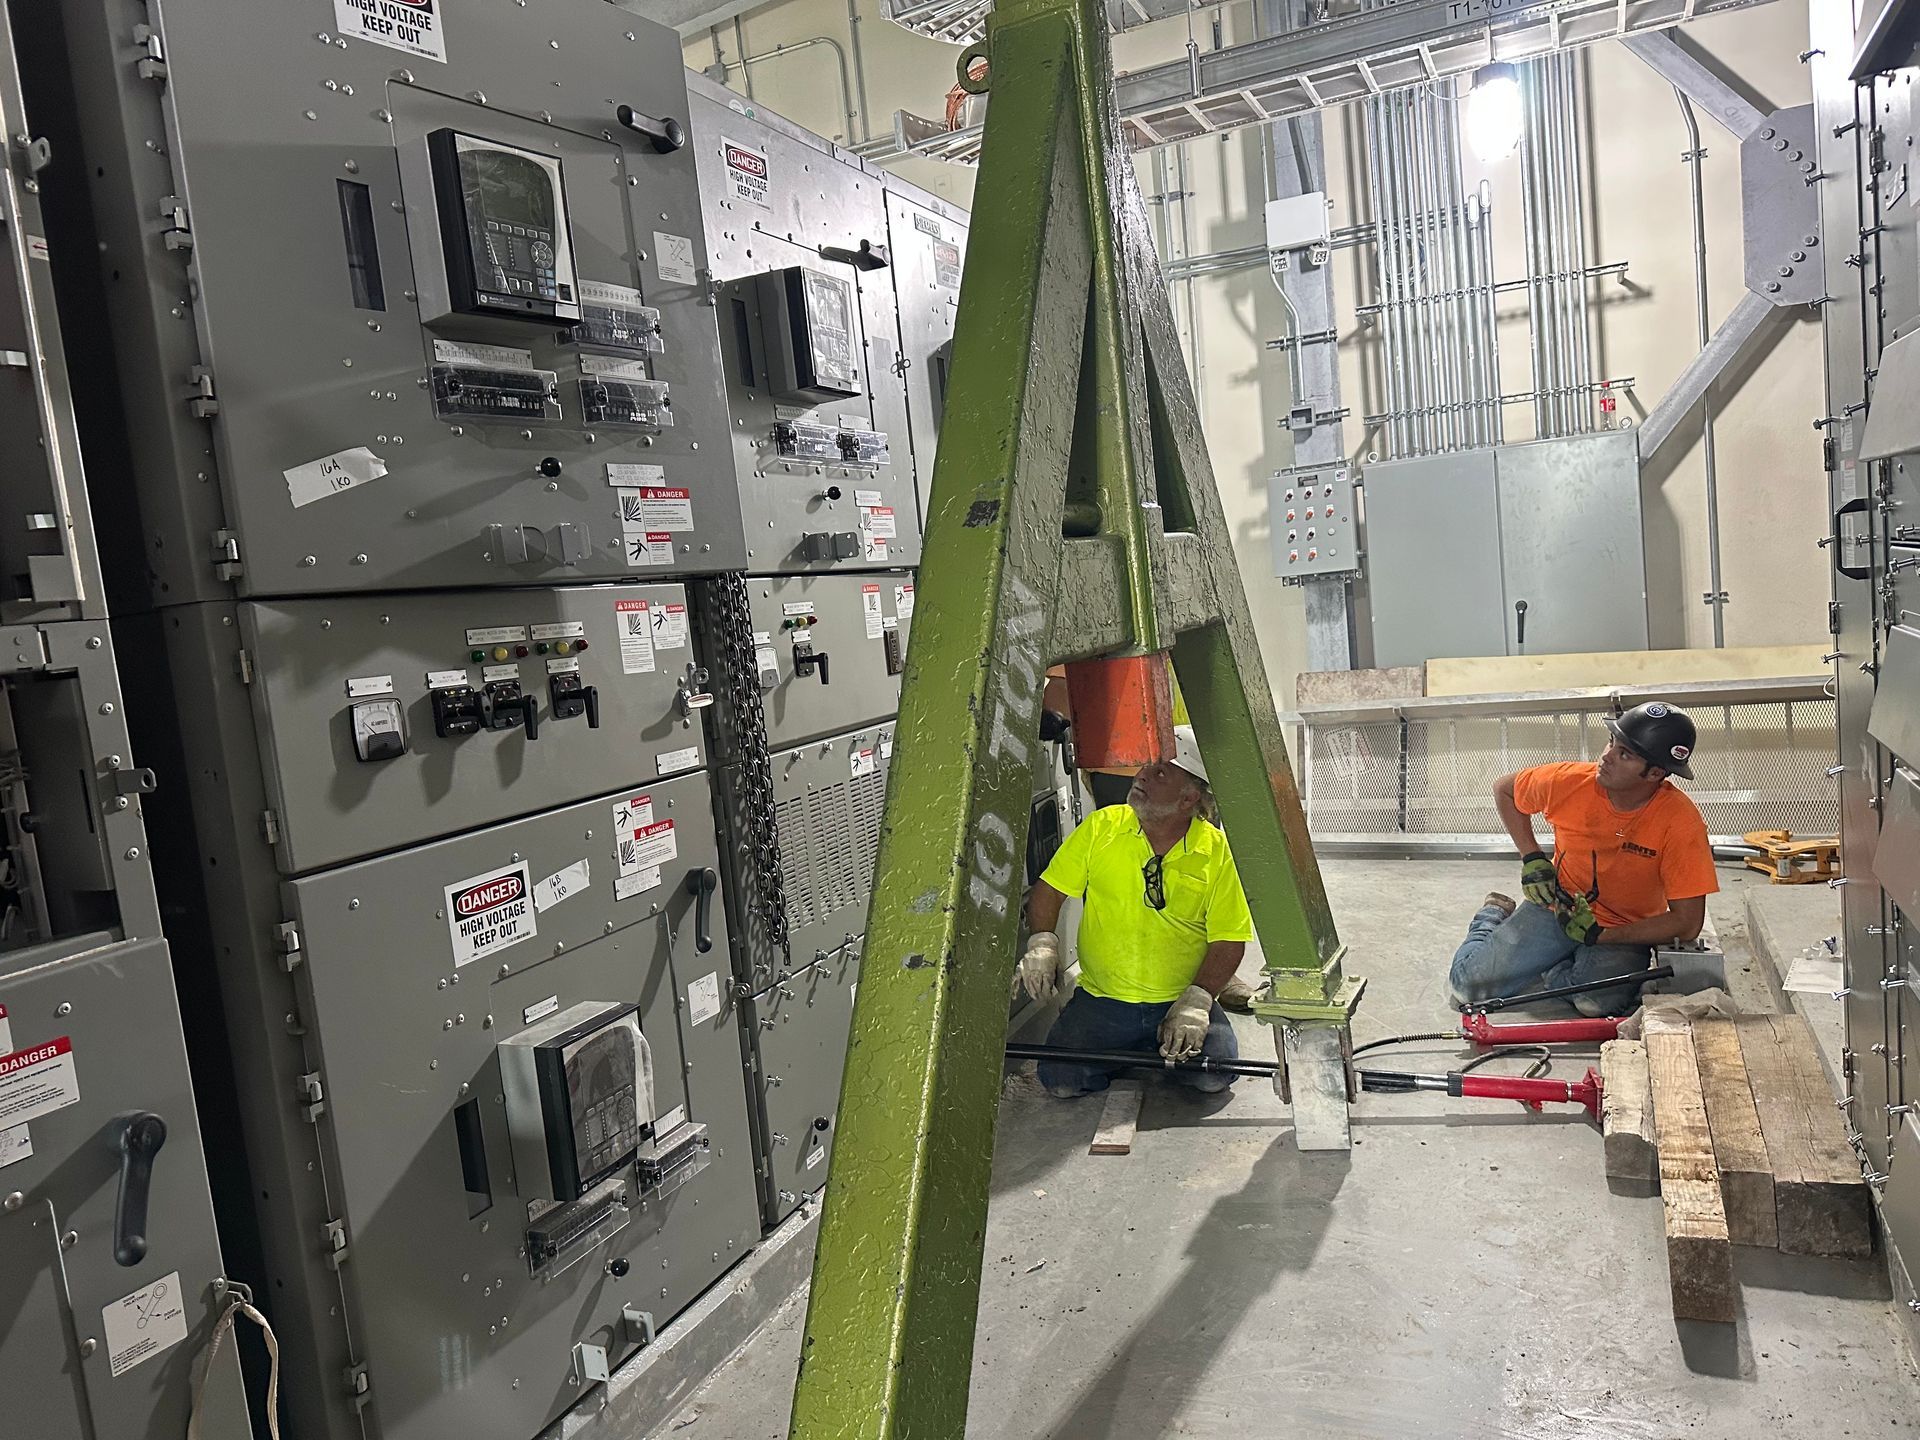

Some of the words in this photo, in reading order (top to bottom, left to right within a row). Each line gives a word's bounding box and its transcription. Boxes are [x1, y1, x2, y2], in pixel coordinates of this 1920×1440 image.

[380, 1, 432, 31] VOLTAGE
[362, 13, 393, 36] KEEP
[397, 25, 421, 44] OUT
[730, 151, 763, 174] DANGER
[729, 169, 744, 184] HIGH
[744, 175, 768, 193] VOLTAGE
[737, 184, 751, 197] KEEP
[752, 189, 763, 202] OUT
[320, 459, 341, 476] 16A
[657, 490, 684, 498] DANGER
[623, 602, 647, 610] DANGER
[988, 575, 1047, 766] TON
[635, 797, 651, 806] DANGER
[648, 822, 670, 835] DANGER
[549, 874, 561, 889] 16B
[462, 879, 518, 912] DANGER
[460, 917, 484, 938] HIGH
[486, 901, 526, 927] VOLTAGE
[472, 928, 497, 949] KEEP
[500, 920, 517, 938] OUT
[0, 1045, 58, 1075] DANGER
